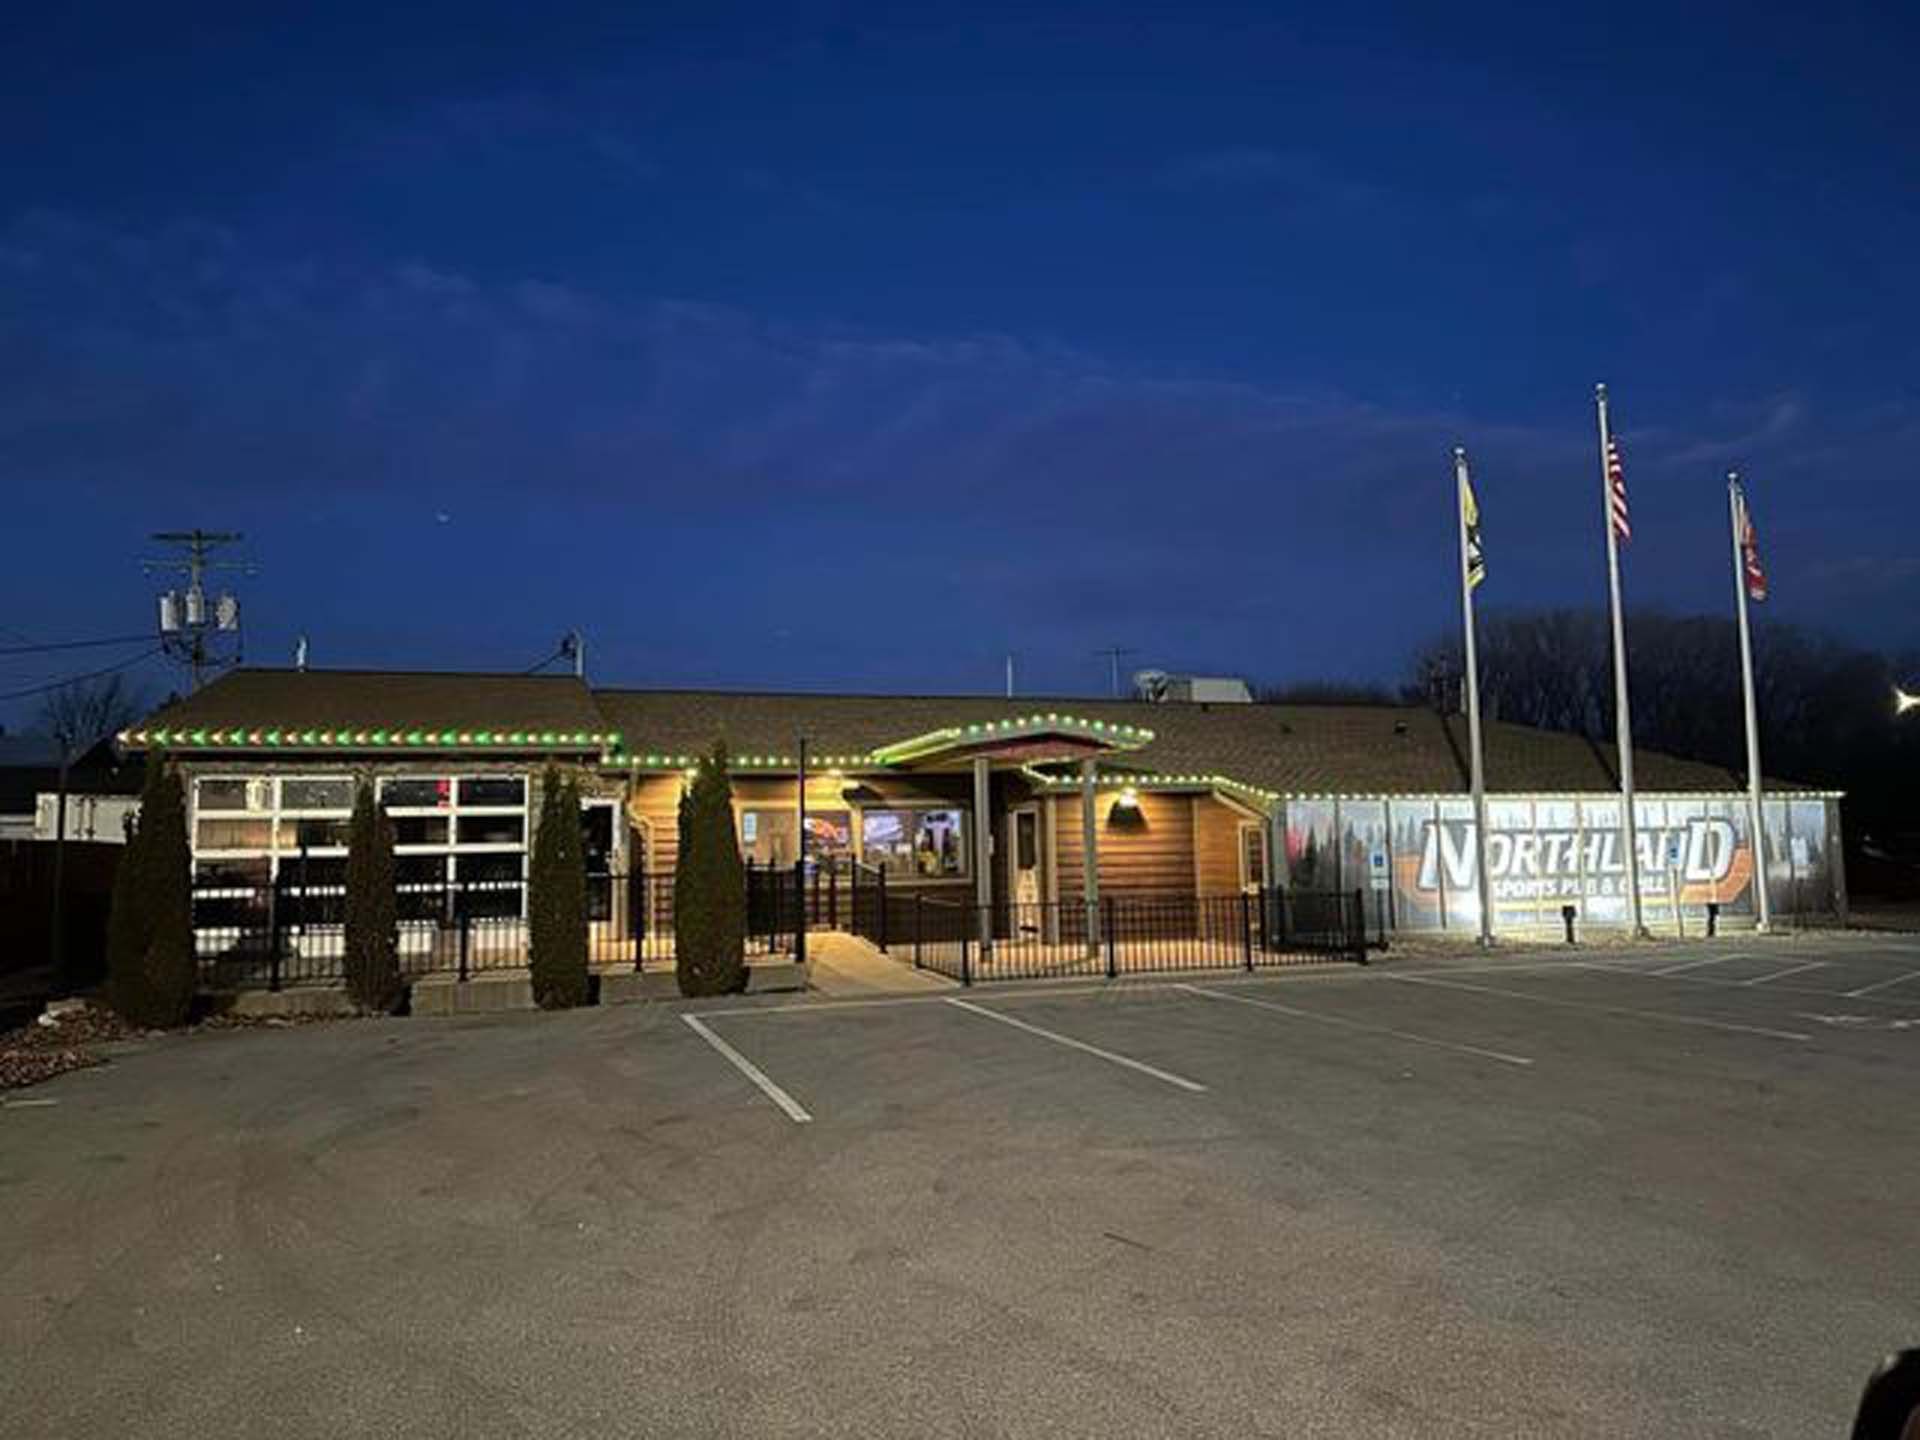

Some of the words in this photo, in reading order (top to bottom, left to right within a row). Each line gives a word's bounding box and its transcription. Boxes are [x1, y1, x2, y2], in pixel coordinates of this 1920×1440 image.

[1418, 820, 1736, 889] NORTHLAND
[1601, 876, 1613, 895] &
[1618, 874, 1667, 894] GILL
